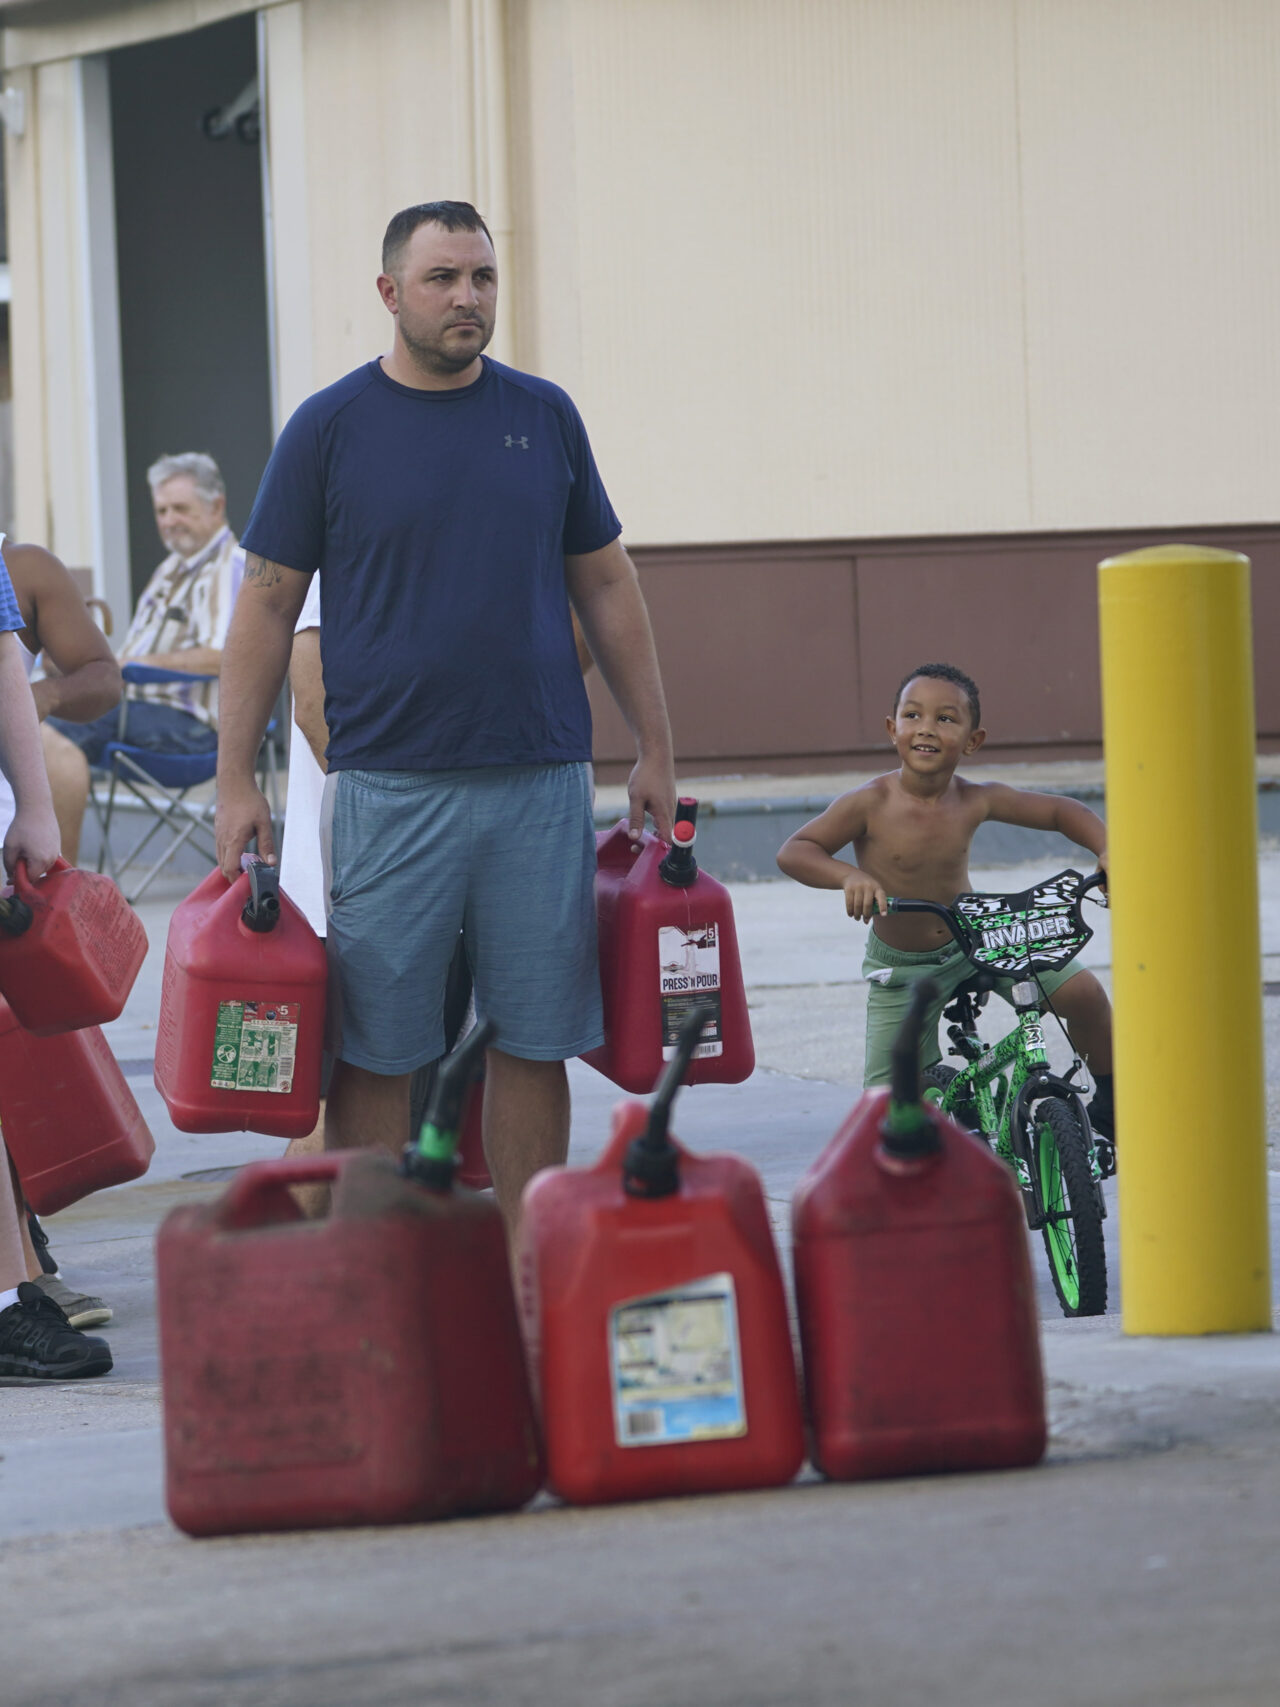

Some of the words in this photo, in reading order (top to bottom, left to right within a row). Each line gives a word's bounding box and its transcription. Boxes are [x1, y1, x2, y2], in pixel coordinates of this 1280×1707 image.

[708, 928, 715, 939] 5
[982, 915, 1071, 950] INVADER
[663, 977, 688, 990] PRESS
[696, 974, 718, 988] POUR
